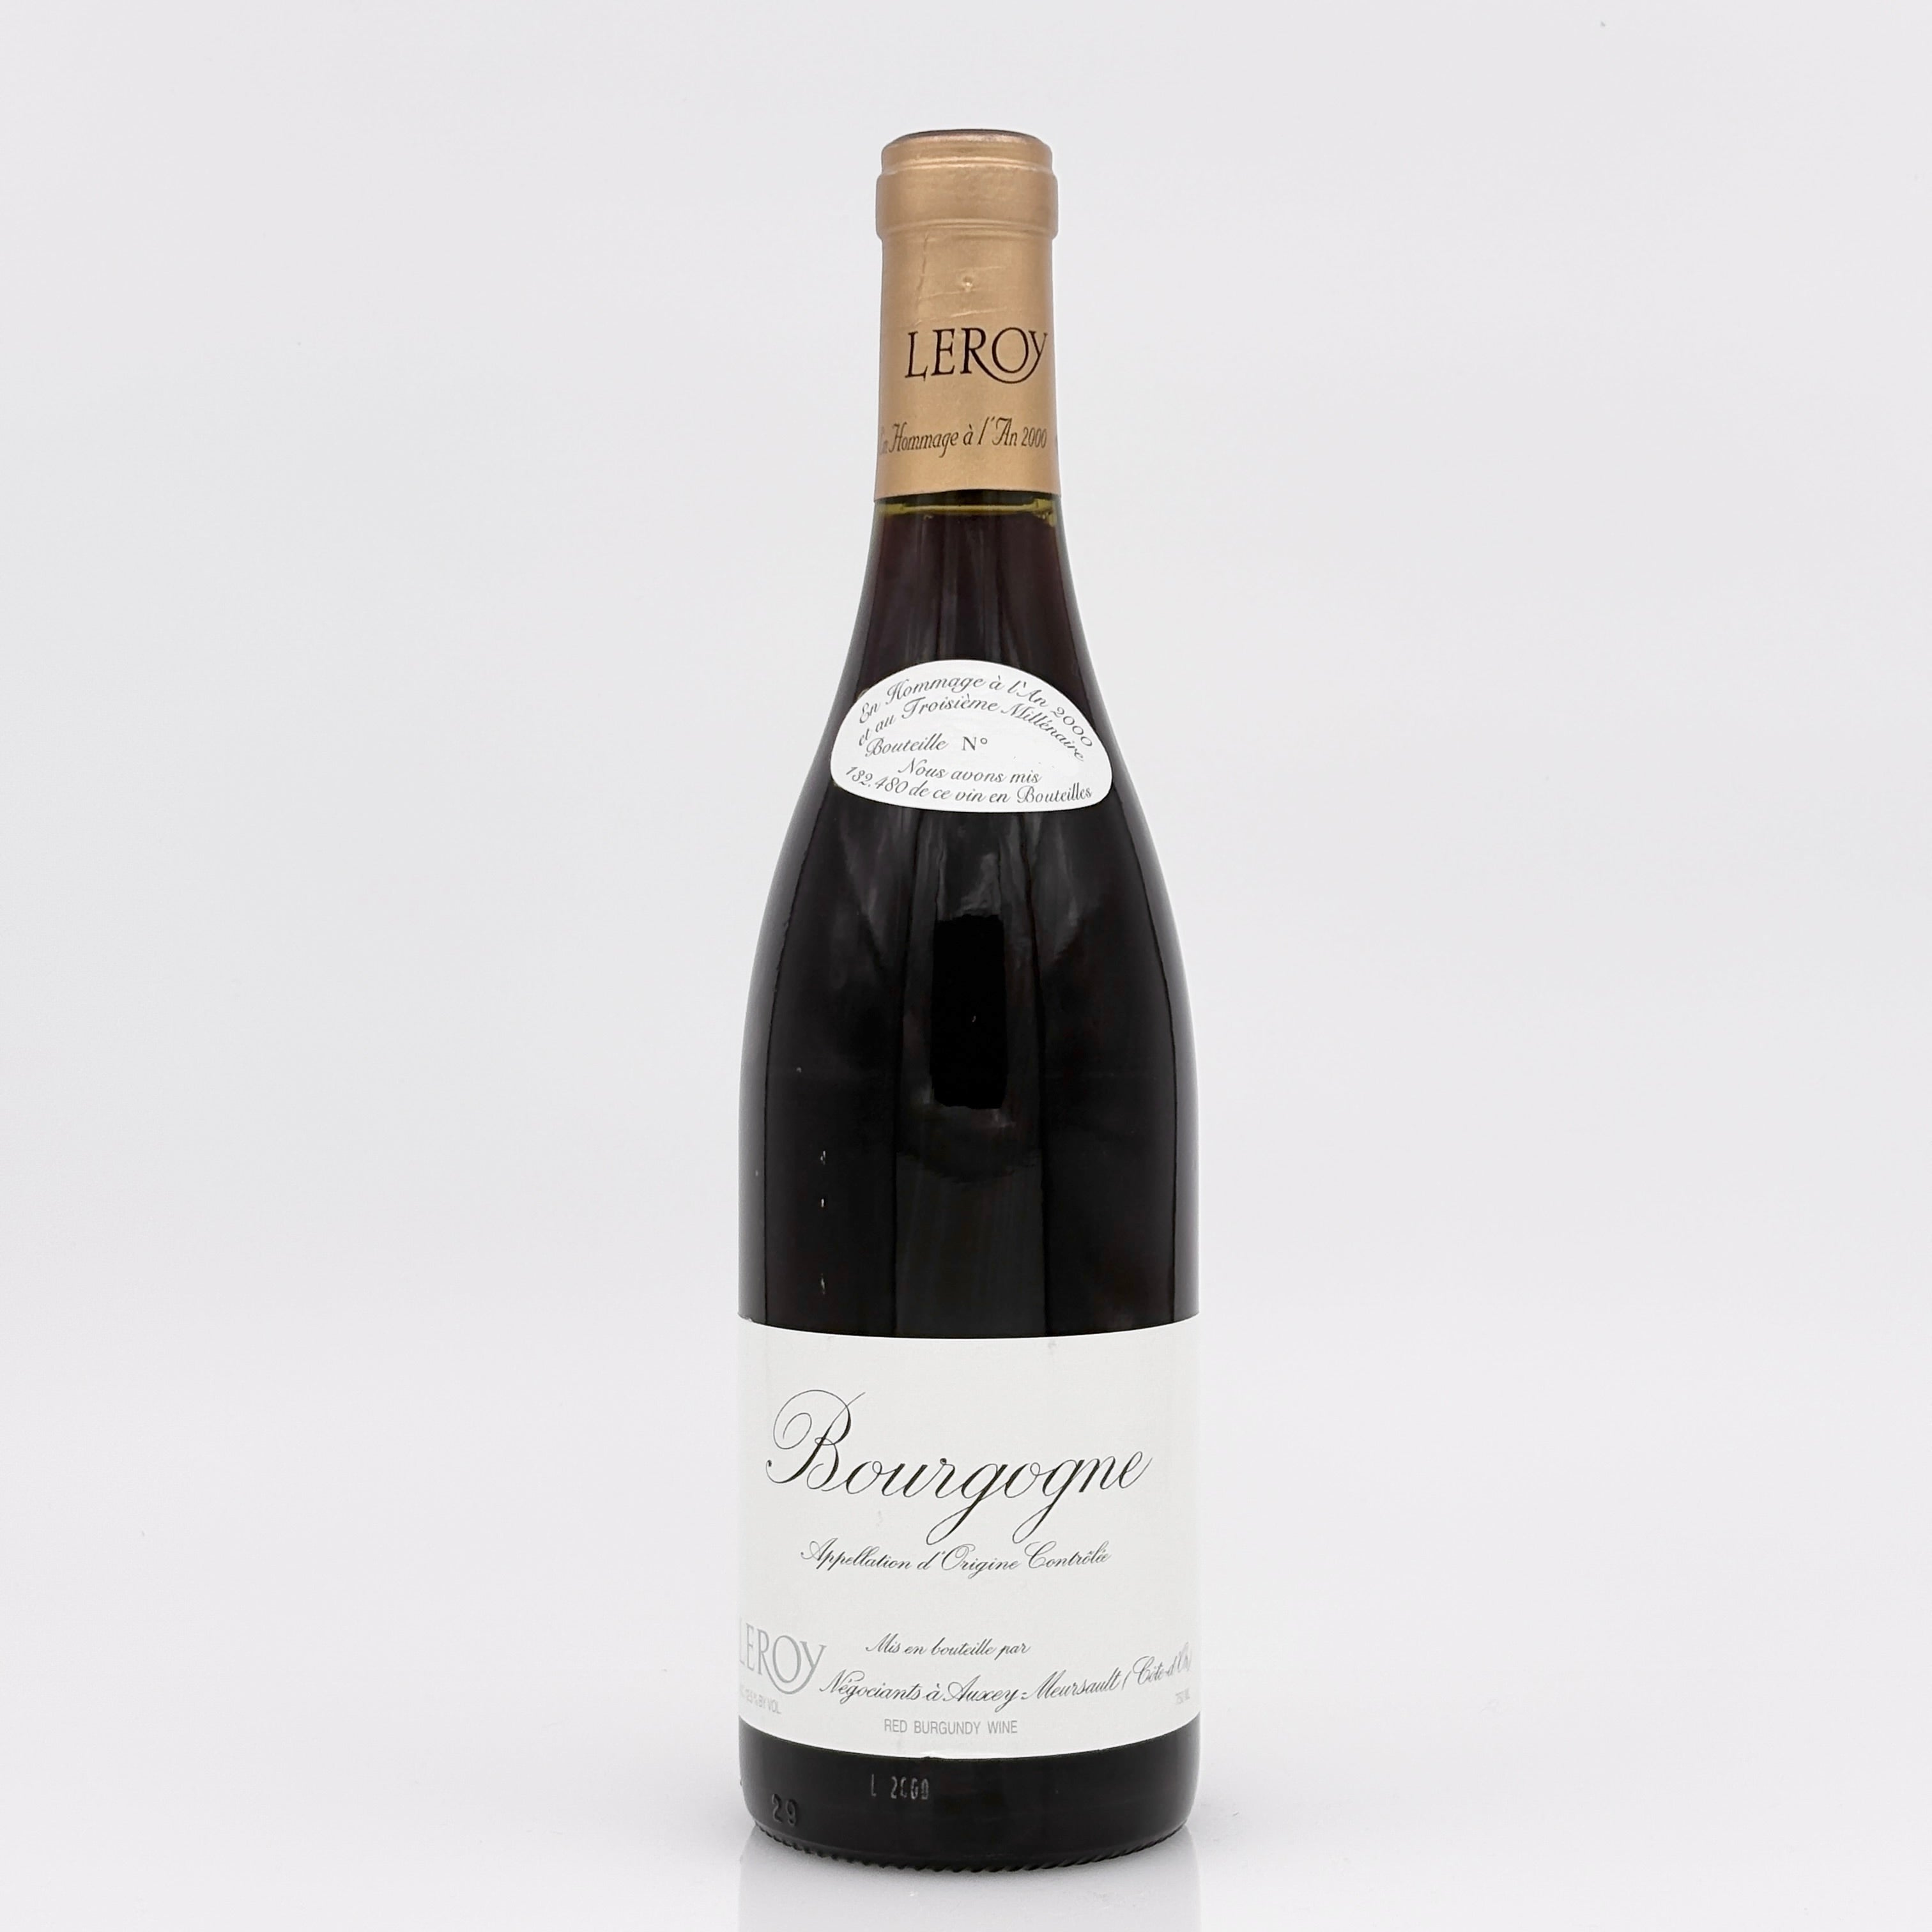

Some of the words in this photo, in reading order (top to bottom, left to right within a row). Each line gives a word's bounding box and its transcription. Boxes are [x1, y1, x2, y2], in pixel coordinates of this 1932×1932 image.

[905, 326, 1048, 385] LEROY
[888, 421, 960, 458] Hommage
[963, 424, 974, 446] à
[1021, 426, 1048, 449] 2000
[858, 728, 871, 746] et
[875, 714, 896, 733] au
[901, 693, 1000, 719] Troisième
[1000, 703, 1084, 762] Millénaire
[859, 702, 880, 724] En
[885, 677, 986, 705] Hommage
[988, 675, 1005, 691] à
[1007, 680, 1048, 708] l'An
[1051, 706, 1093, 747] 2000
[864, 732, 949, 757] Bouteille
[897, 757, 949, 778] Nous
[950, 770, 1008, 783] avons
[1009, 769, 1043, 784] mis
[908, 779, 931, 798] de
[932, 788, 953, 800] ce
[954, 788, 987, 803] vin
[988, 792, 1011, 803] en
[1016, 781, 1092, 804] Bouteilles
[765, 1388, 1153, 1545] Bourgogne
[800, 1537, 913, 1572] Appellation
[739, 1618, 827, 1695] LEROY
[865, 1632, 901, 1653] Mis
[904, 1645, 928, 1655] en
[930, 1636, 997, 1655] bouteille
[993, 1642, 1032, 1661] par
[818, 1668, 923, 1705] Négociants
[923, 1682, 943, 1702] à
[883, 1718, 908, 1734] RED
[914, 1719, 982, 1735] BURGUNDY
[987, 1719, 1018, 1735] WINE
